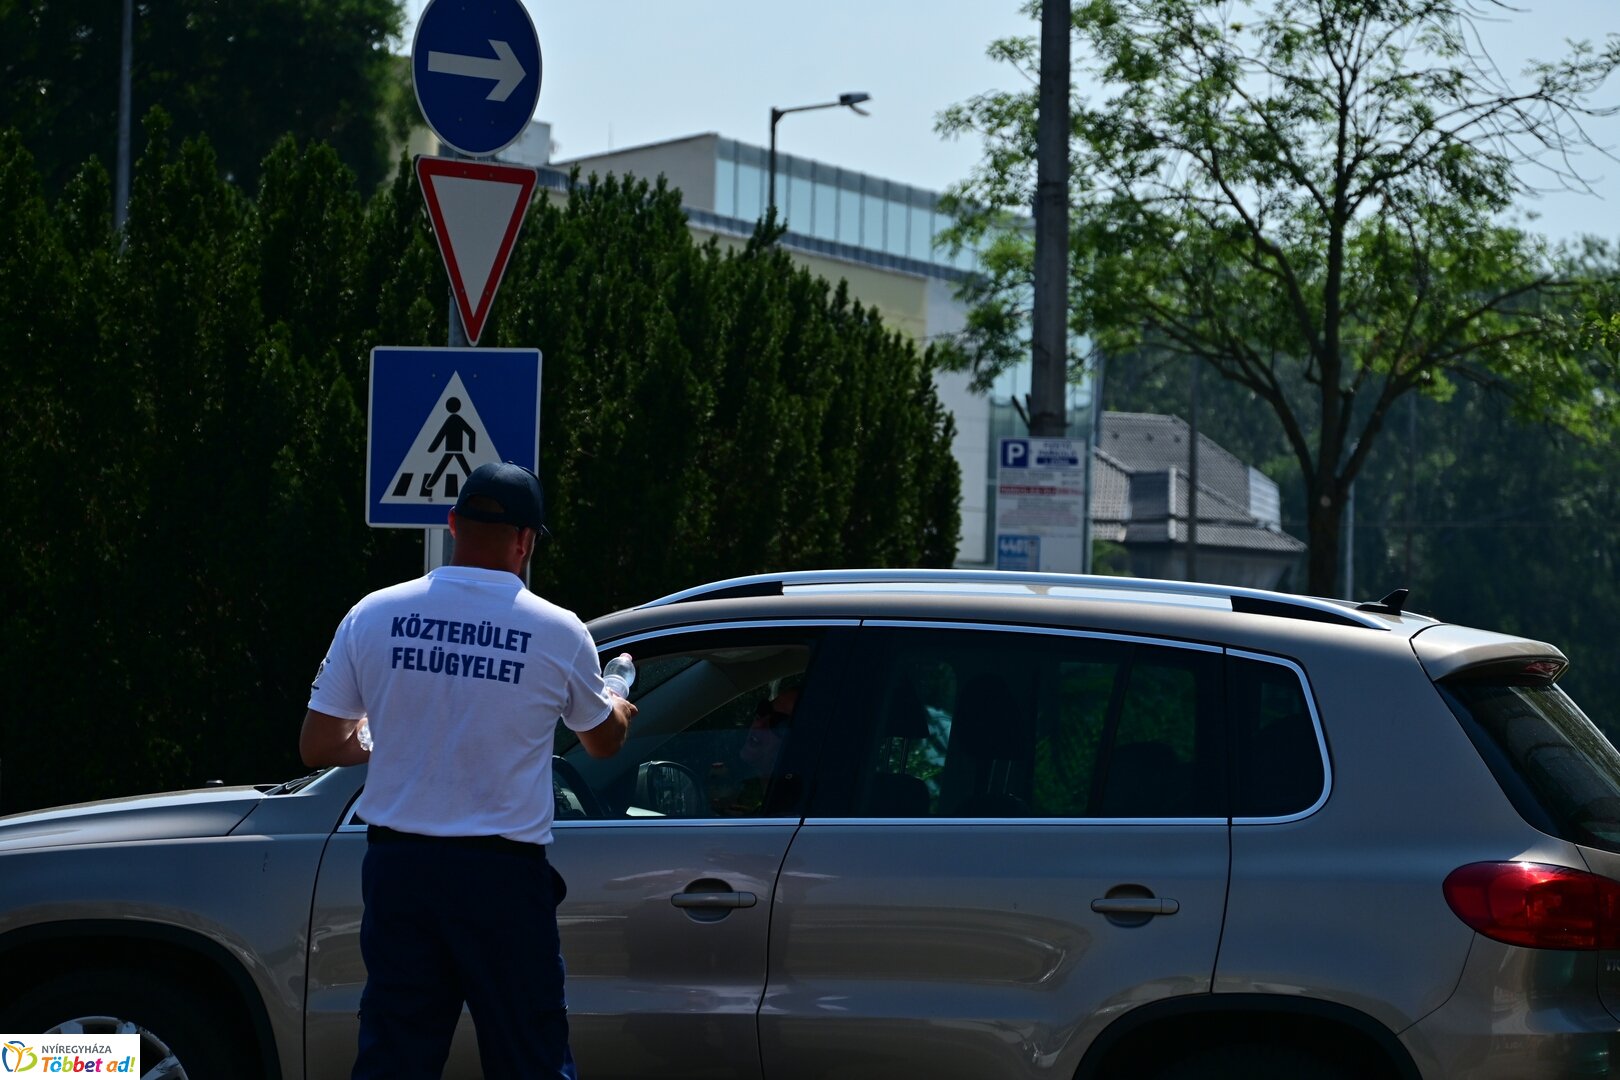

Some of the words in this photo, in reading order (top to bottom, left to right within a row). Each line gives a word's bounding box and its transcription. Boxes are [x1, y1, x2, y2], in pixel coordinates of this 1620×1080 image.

[1006, 443, 1025, 465] P
[391, 613, 532, 653] KÖZTERÜLET
[391, 646, 525, 684] FELÜGYELET
